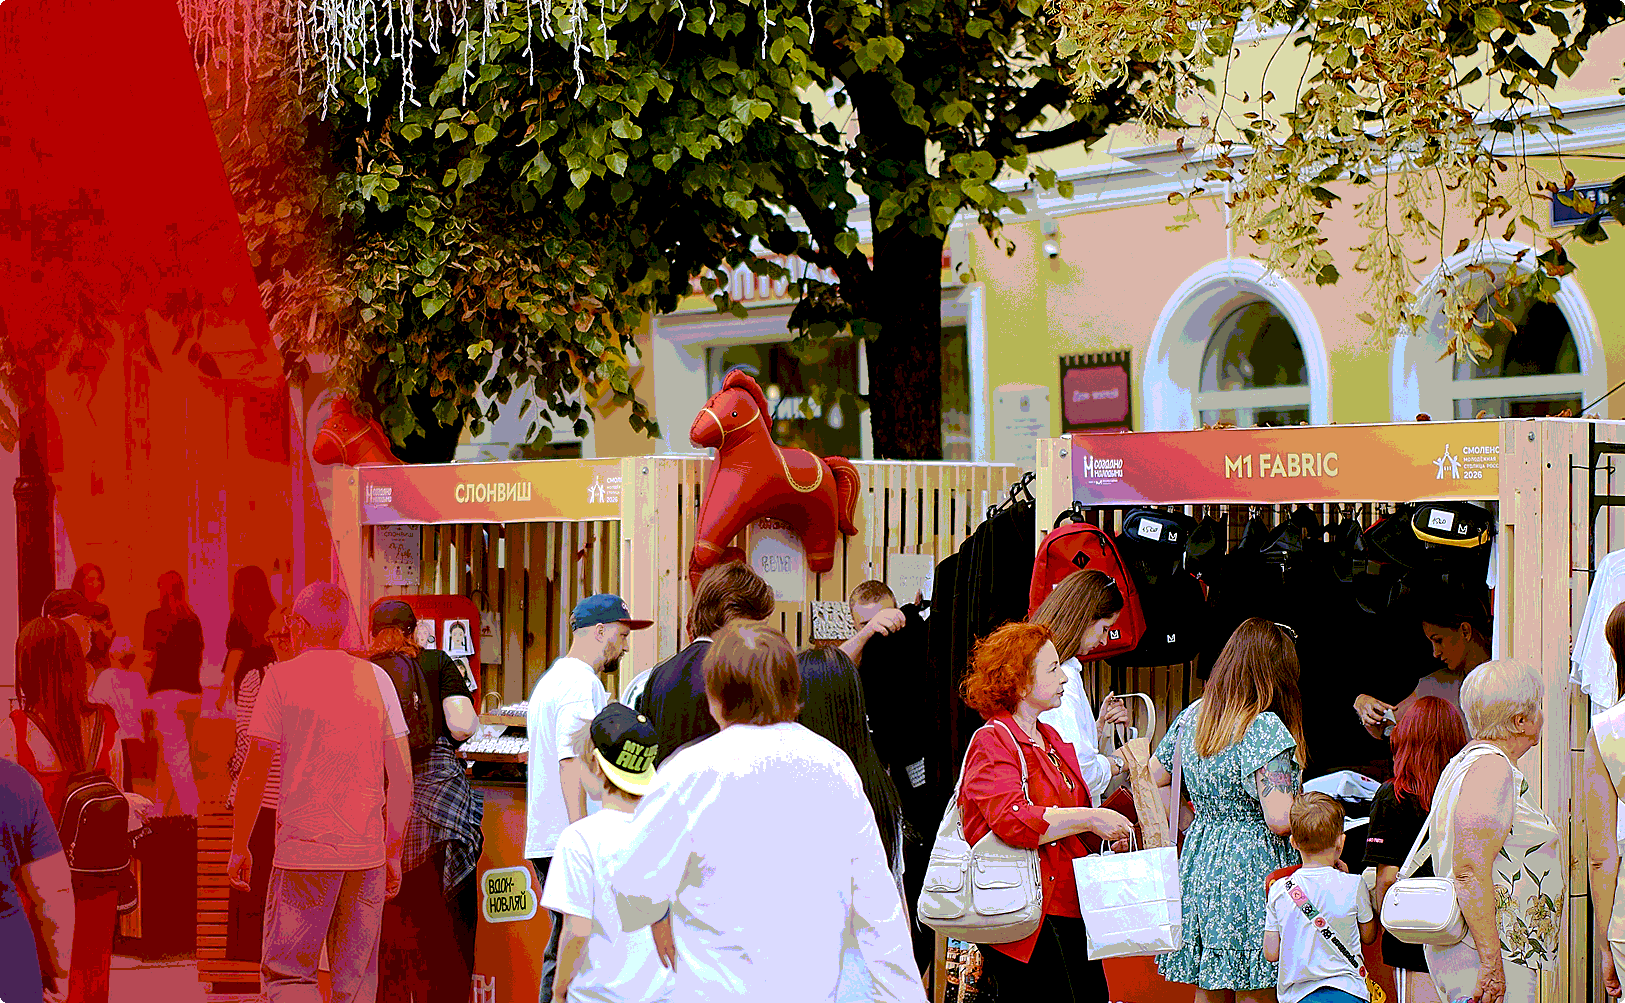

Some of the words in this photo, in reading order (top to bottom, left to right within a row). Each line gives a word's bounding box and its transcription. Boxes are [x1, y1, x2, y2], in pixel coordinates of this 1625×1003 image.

[1224, 454, 1253, 479] M1
[1259, 452, 1339, 478] FABRIC
[1463, 471, 1483, 479] 2026
[455, 482, 531, 503] СЛОНВИШ
[622, 739, 645, 756] MY
[488, 877, 515, 894] ВДОХ-
[489, 890, 527, 914] НОВЛЯЙ
